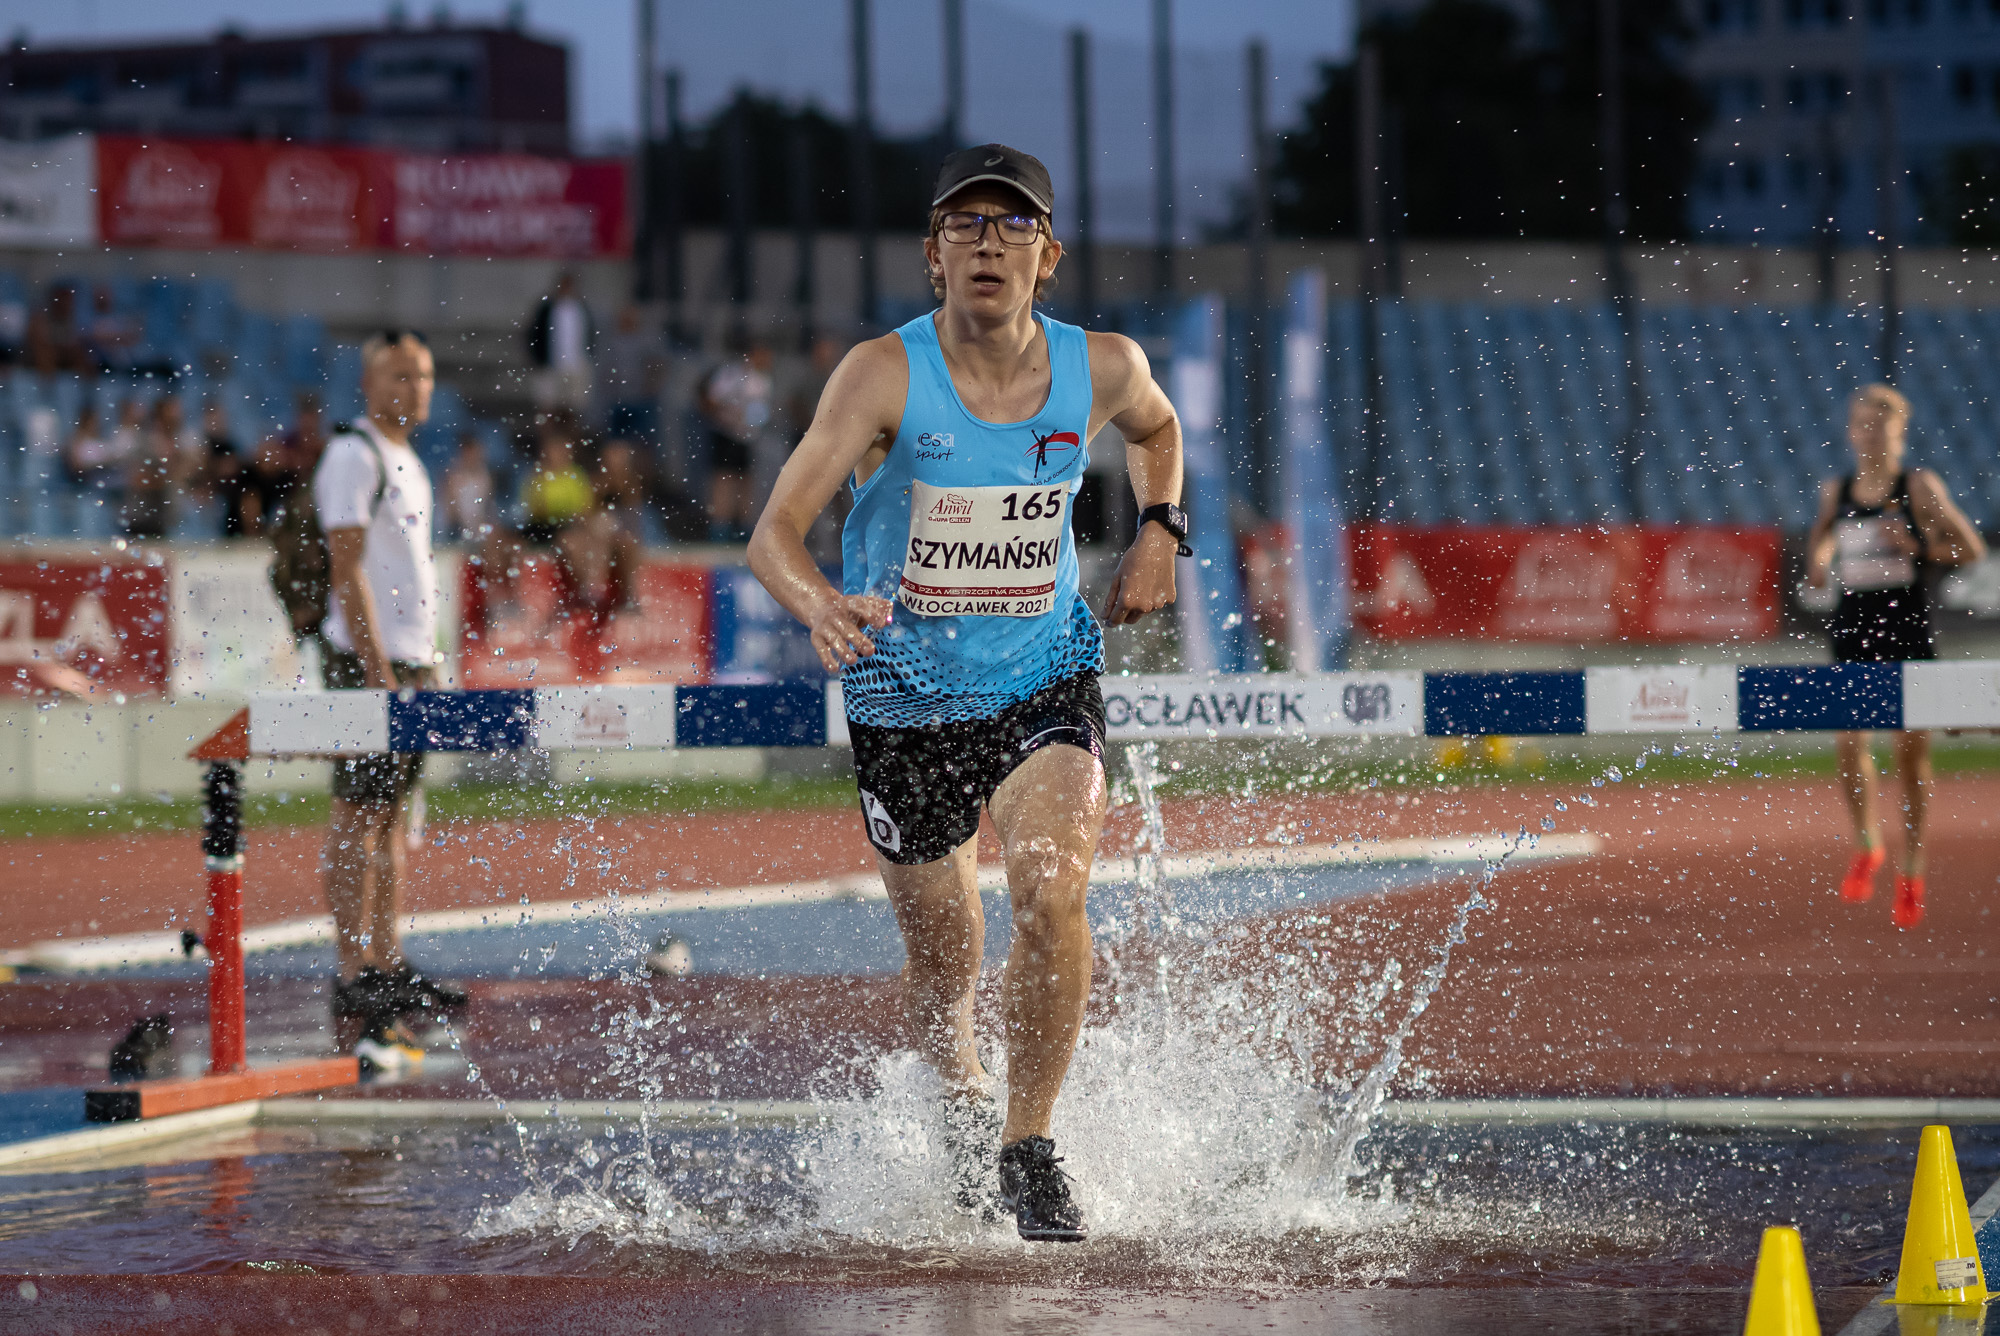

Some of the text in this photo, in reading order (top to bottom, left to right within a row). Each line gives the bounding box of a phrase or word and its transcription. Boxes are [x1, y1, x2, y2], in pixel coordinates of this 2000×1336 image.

[930, 496, 974, 515] Anwil
[1001, 489, 1062, 521] 165
[908, 536, 1060, 570] SZYMAŃSKI
[904, 593, 1049, 614] WŁOCŁAWEK 2021
[918, 586, 943, 595] PZLA
[943, 587, 1008, 596] MISTRZOSTWA
[1008, 586, 1039, 596] POLSKI
[1103, 691, 1305, 728] OCŁAWEK
